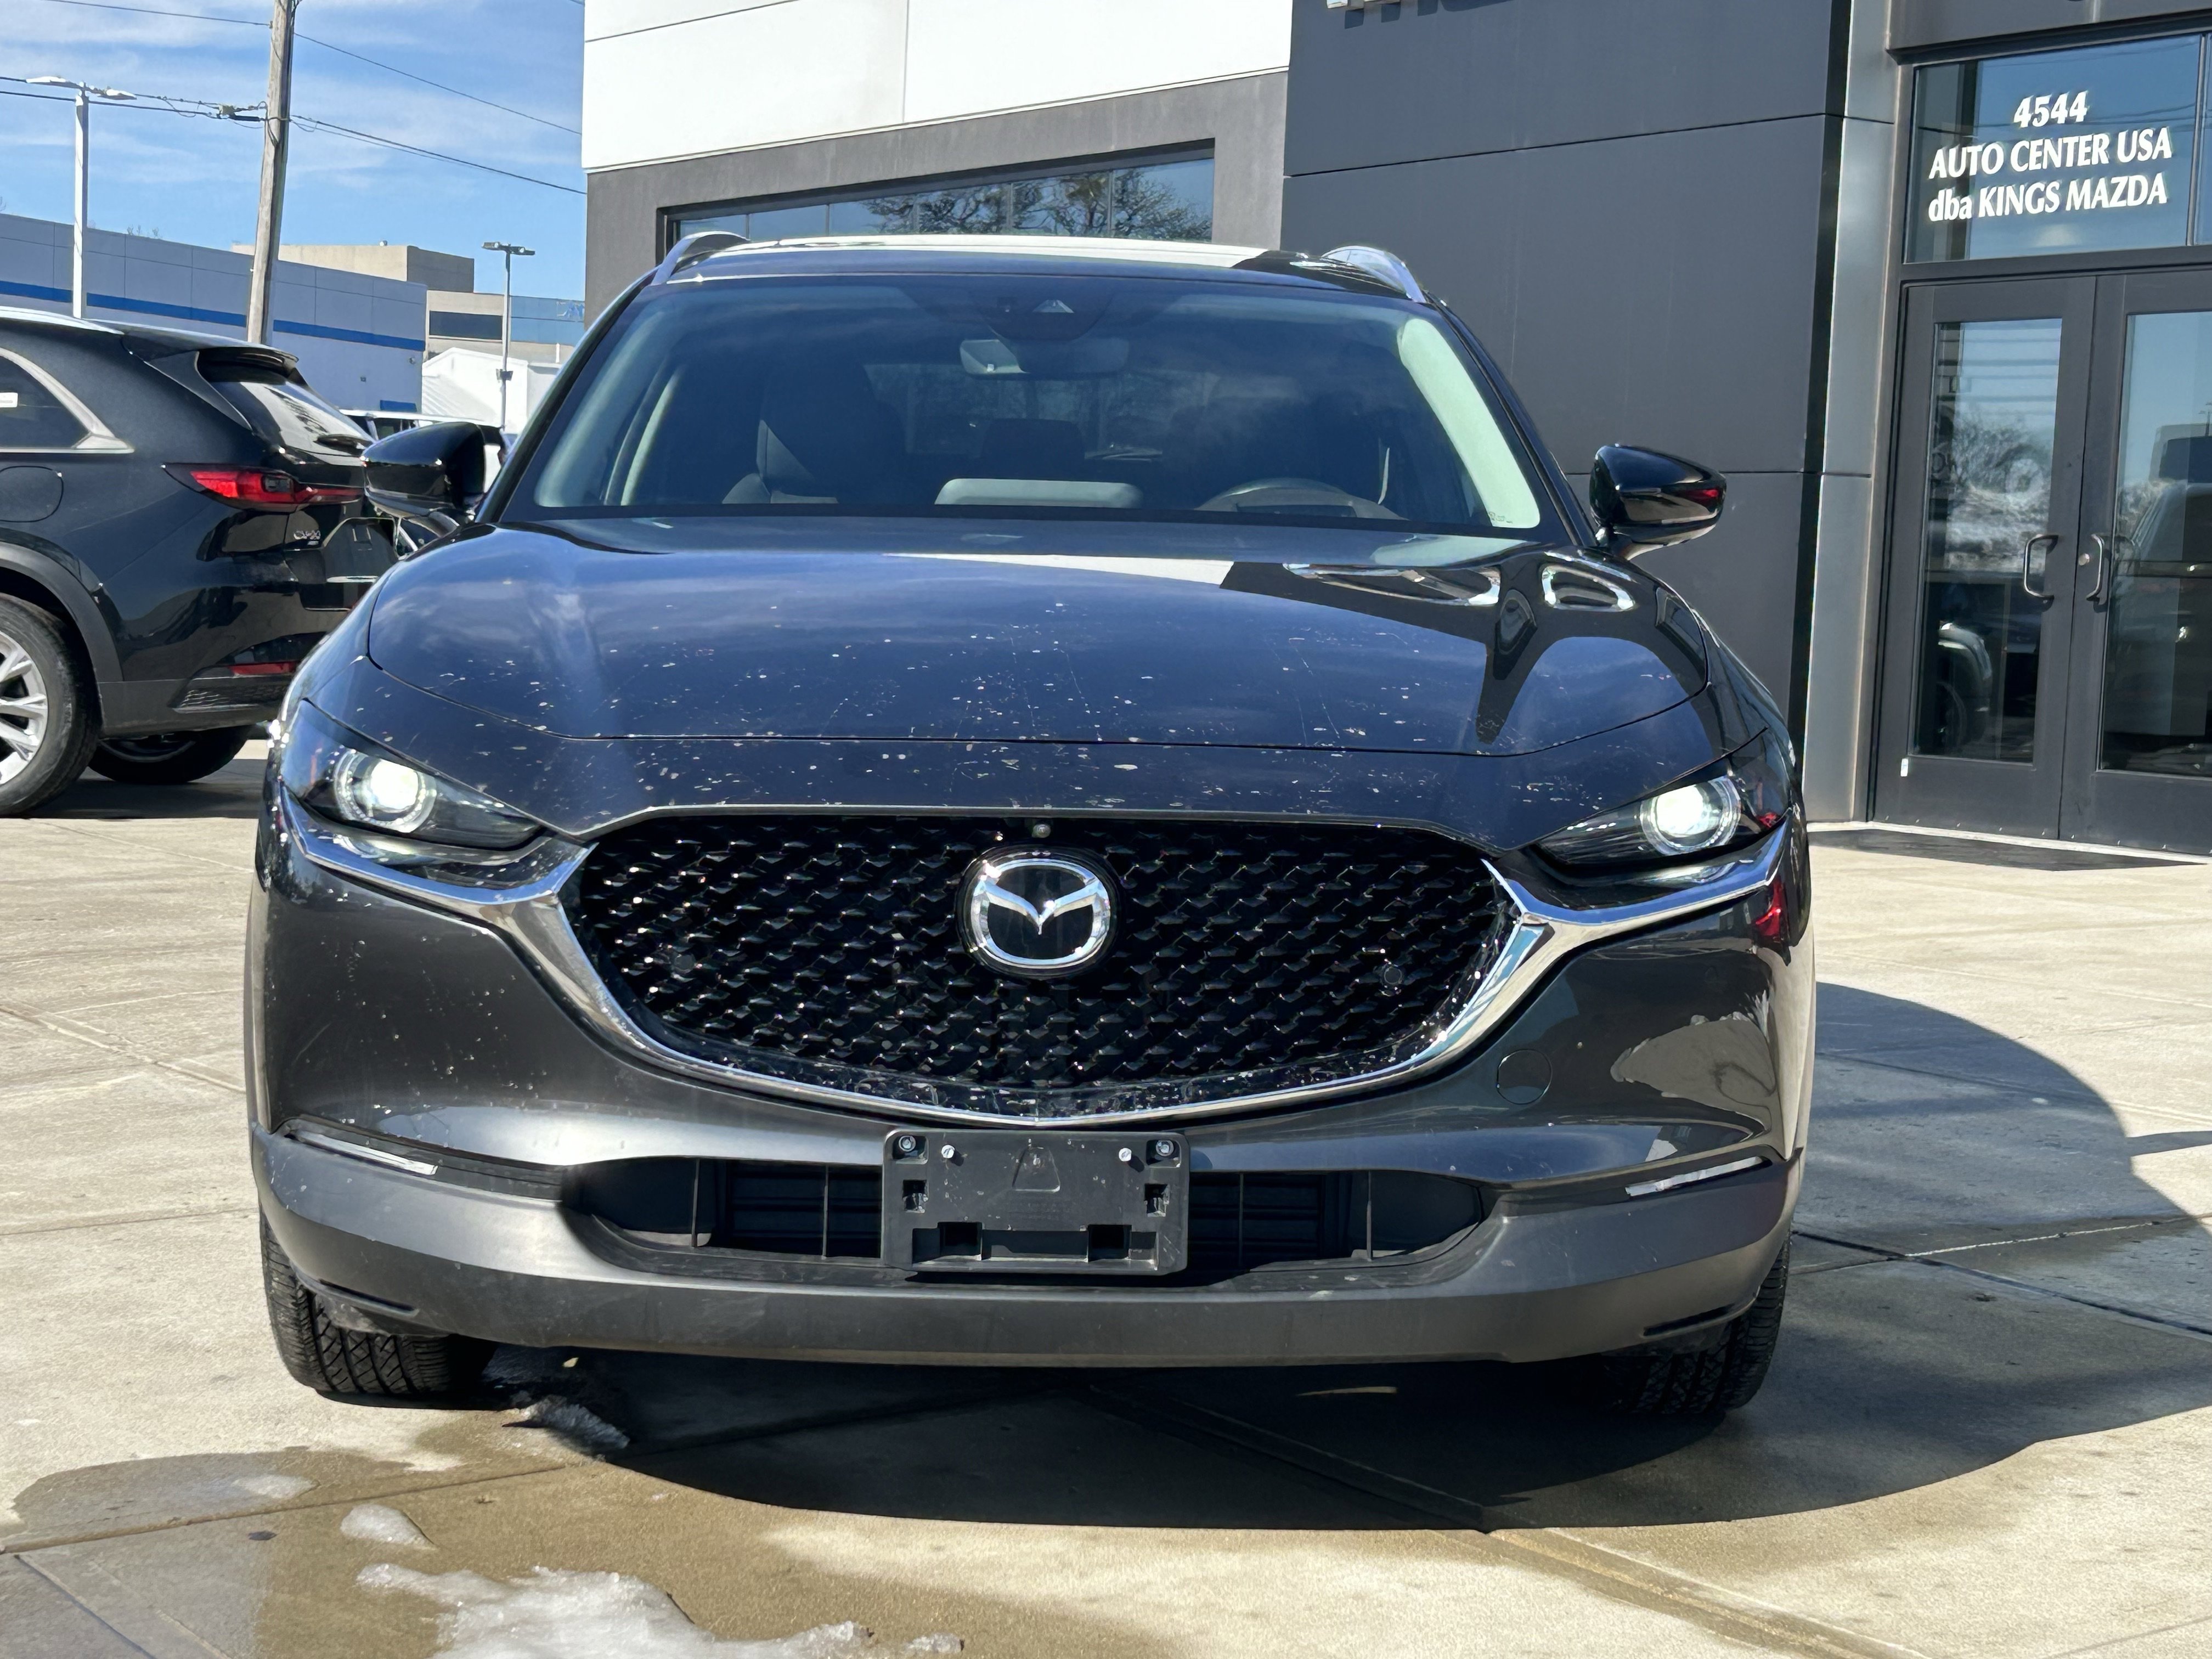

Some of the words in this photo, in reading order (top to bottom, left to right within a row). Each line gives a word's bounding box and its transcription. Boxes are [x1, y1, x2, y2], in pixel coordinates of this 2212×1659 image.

[2013, 89, 2089, 128] 4544
[1928, 142, 2005, 180] AUTO
[2010, 133, 2110, 172] CENTER
[2117, 126, 2172, 163] USA
[1928, 187, 1973, 222] dba
[1978, 180, 2061, 218] KINGS
[2065, 172, 2168, 211] MAZDA
